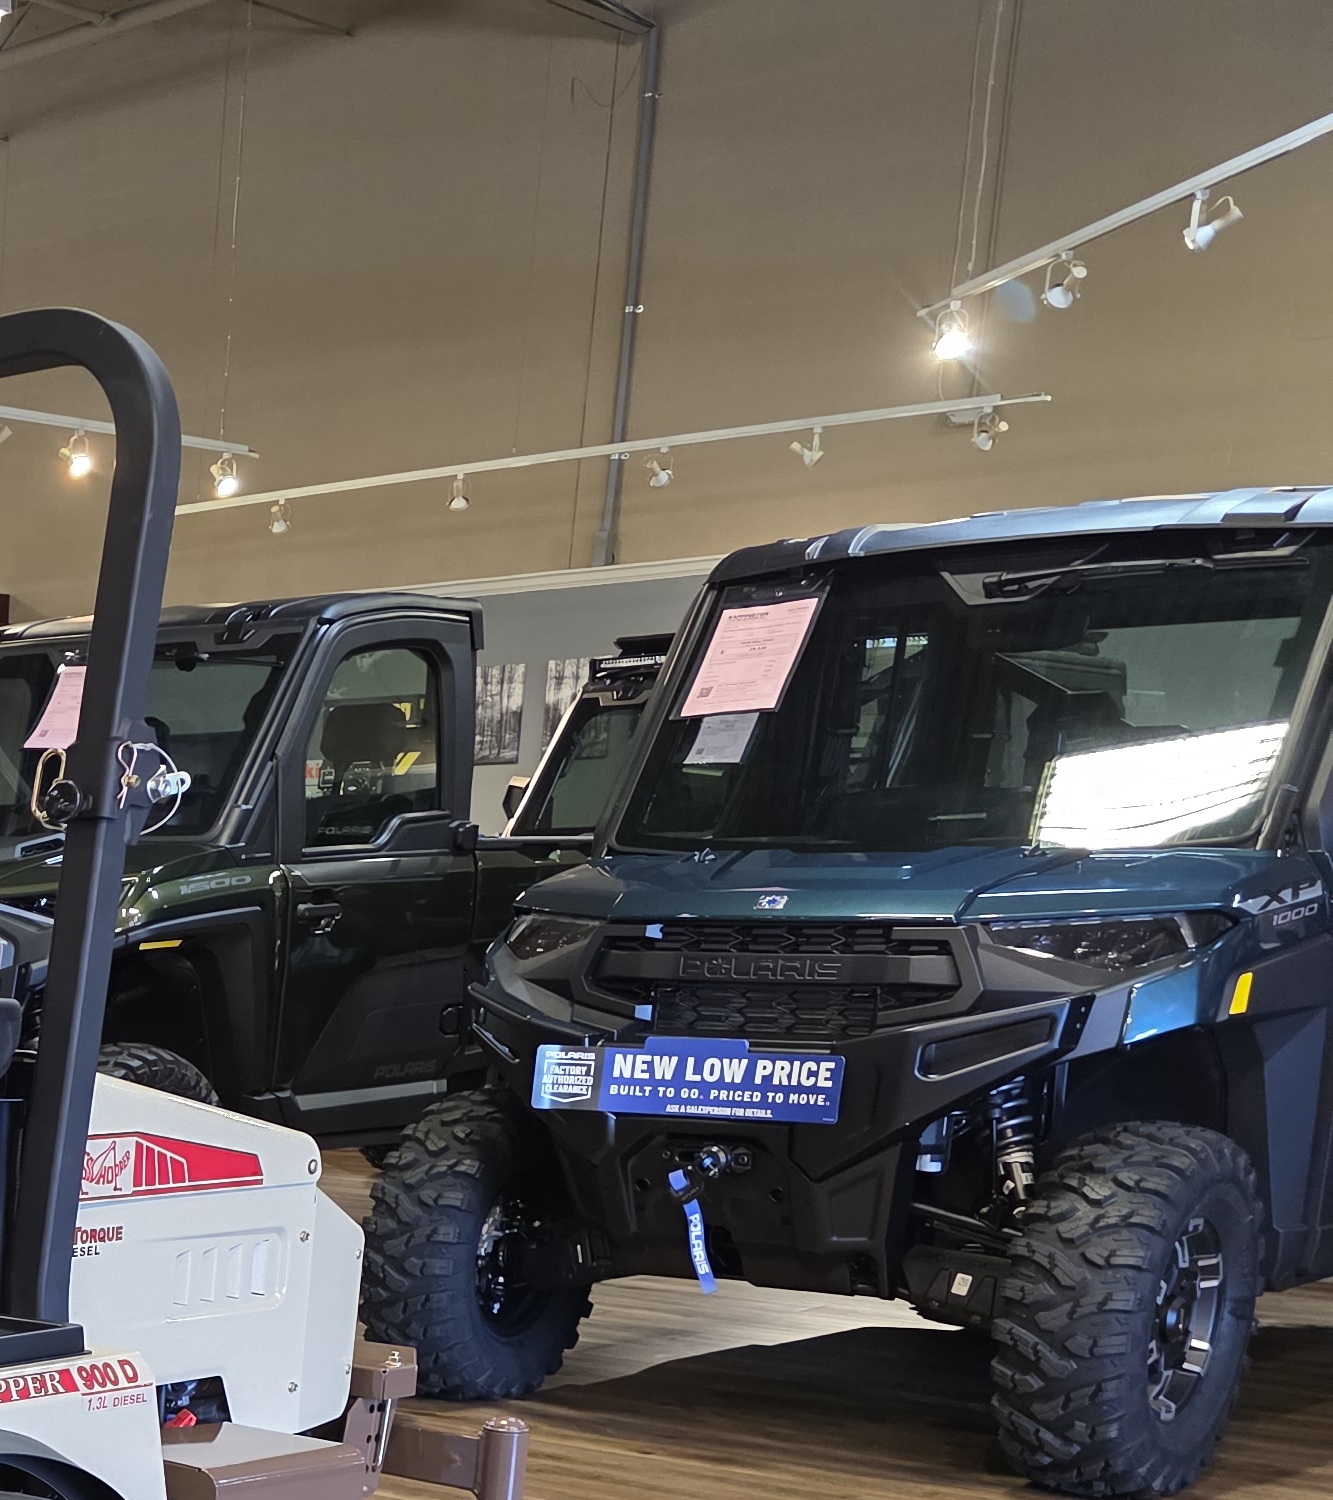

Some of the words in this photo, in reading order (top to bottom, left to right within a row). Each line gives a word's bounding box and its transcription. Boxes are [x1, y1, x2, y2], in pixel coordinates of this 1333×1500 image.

[180, 875, 252, 895] 1500
[1273, 903, 1318, 926] 1000
[679, 956, 842, 980] POLARIS
[545, 1050, 595, 1060] POLARIS
[541, 1074, 594, 1086] AUTHORIZED
[550, 1064, 588, 1076] FACTORY
[612, 1053, 679, 1081] NEW
[685, 1056, 745, 1084] LOW
[754, 1059, 836, 1088] PRICE
[544, 1084, 588, 1094] CLEARANCE
[609, 1084, 651, 1097] BUILT
[658, 1086, 675, 1097] TO
[680, 1087, 705, 1100] GO.
[709, 1089, 761, 1103] PRICED
[767, 1092, 784, 1103] TO
[789, 1093, 830, 1106] MOVE.
[665, 1103, 679, 1112] ASK
[686, 1104, 731, 1116] SALESPERSON
[732, 1107, 744, 1116] FOR
[688, 1213, 710, 1275] POLARIS
[77, 1362, 119, 1390] 900
[120, 1359, 139, 1384] D
[87, 1394, 109, 1411] 1.3L
[112, 1393, 148, 1409] DIESEL
